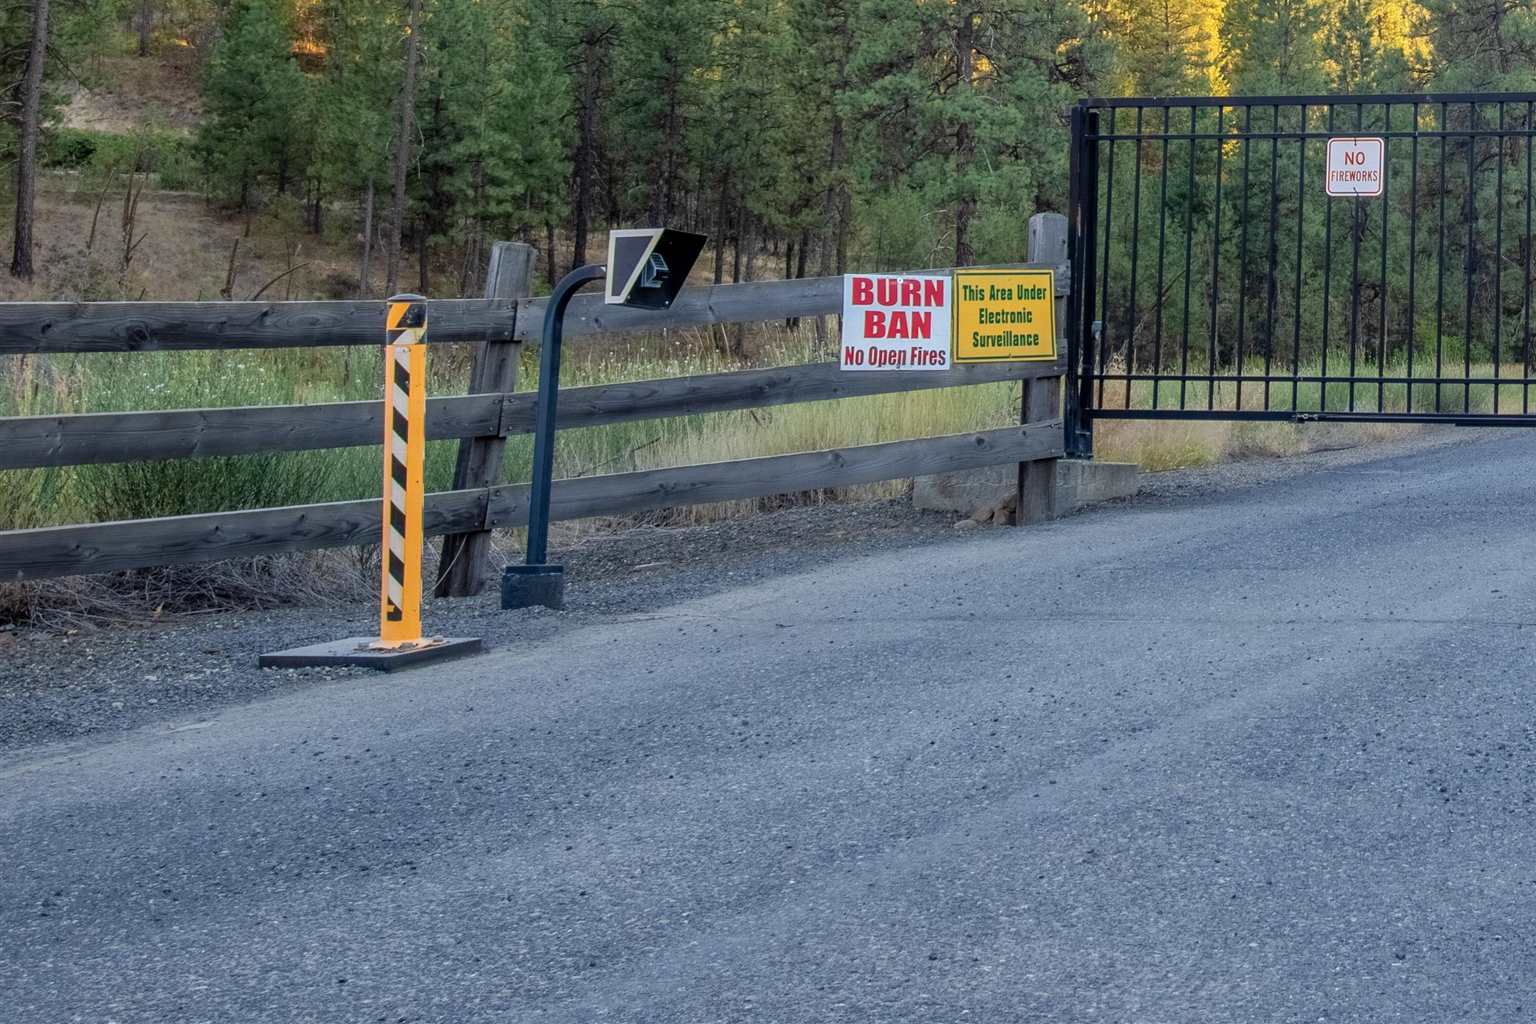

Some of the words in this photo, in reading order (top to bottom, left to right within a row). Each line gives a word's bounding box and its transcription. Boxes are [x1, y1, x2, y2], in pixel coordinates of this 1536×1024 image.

[1345, 151, 1366, 165] NO
[1331, 170, 1378, 183] FIREWORKS
[852, 277, 944, 307] BURN
[962, 284, 985, 301] This
[989, 284, 1013, 301] Area
[1017, 284, 1047, 301] Under
[978, 307, 1033, 324] Electronic
[864, 310, 932, 339] BAN
[972, 330, 1040, 348] Surveillance
[844, 345, 865, 366] No
[868, 346, 907, 368] Open
[910, 346, 947, 366] Fires
